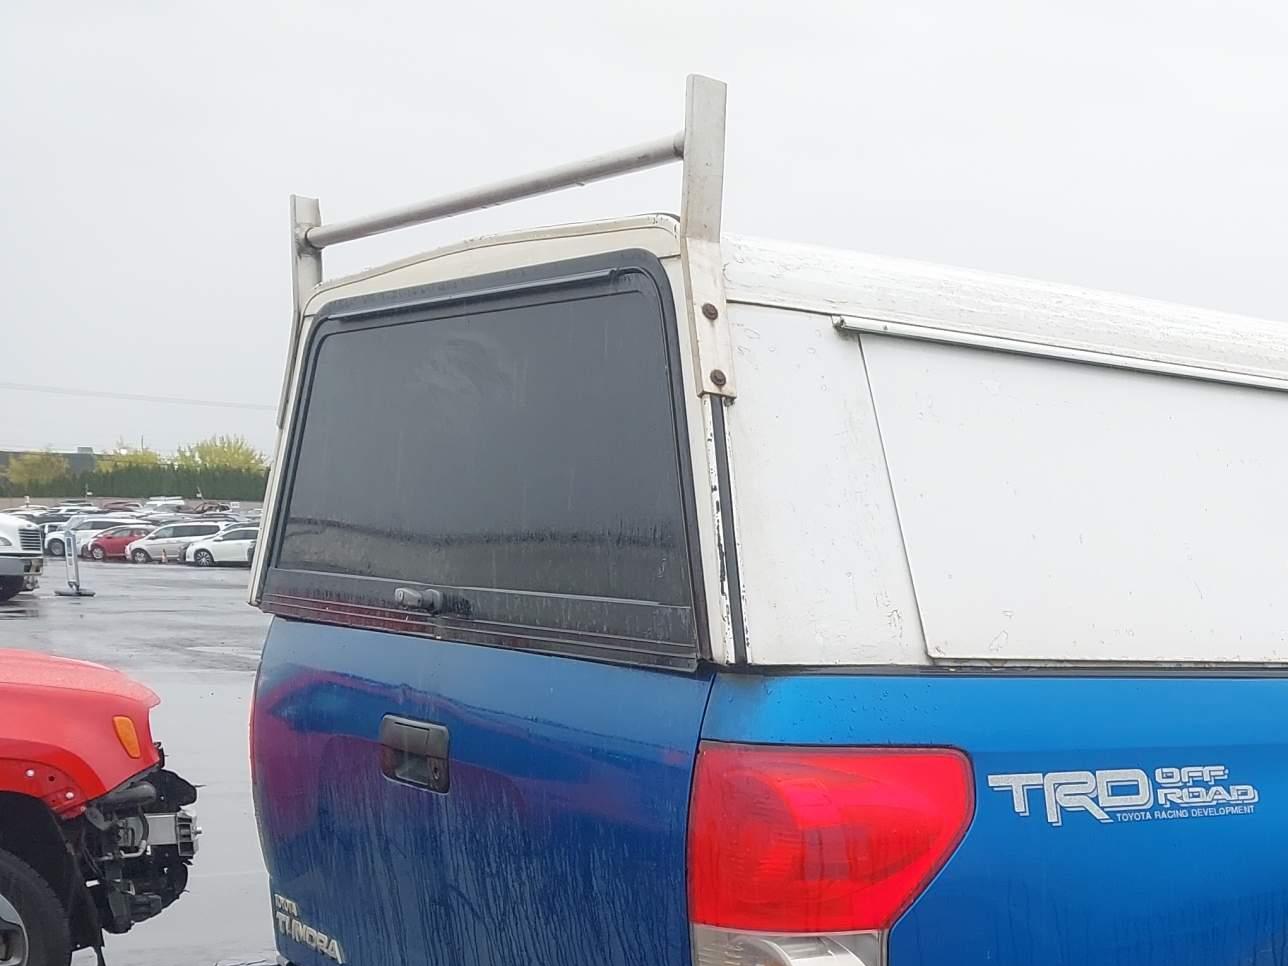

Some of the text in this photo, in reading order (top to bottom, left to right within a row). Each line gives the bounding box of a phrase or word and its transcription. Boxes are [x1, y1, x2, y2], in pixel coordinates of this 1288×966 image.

[1155, 765, 1229, 786] OFF
[988, 768, 1153, 826] TRD
[1157, 784, 1260, 807] ROAD
[1116, 805, 1255, 823] TOYOTA RACING DEVELOPMENT
[276, 911, 346, 965] TUNDRA
